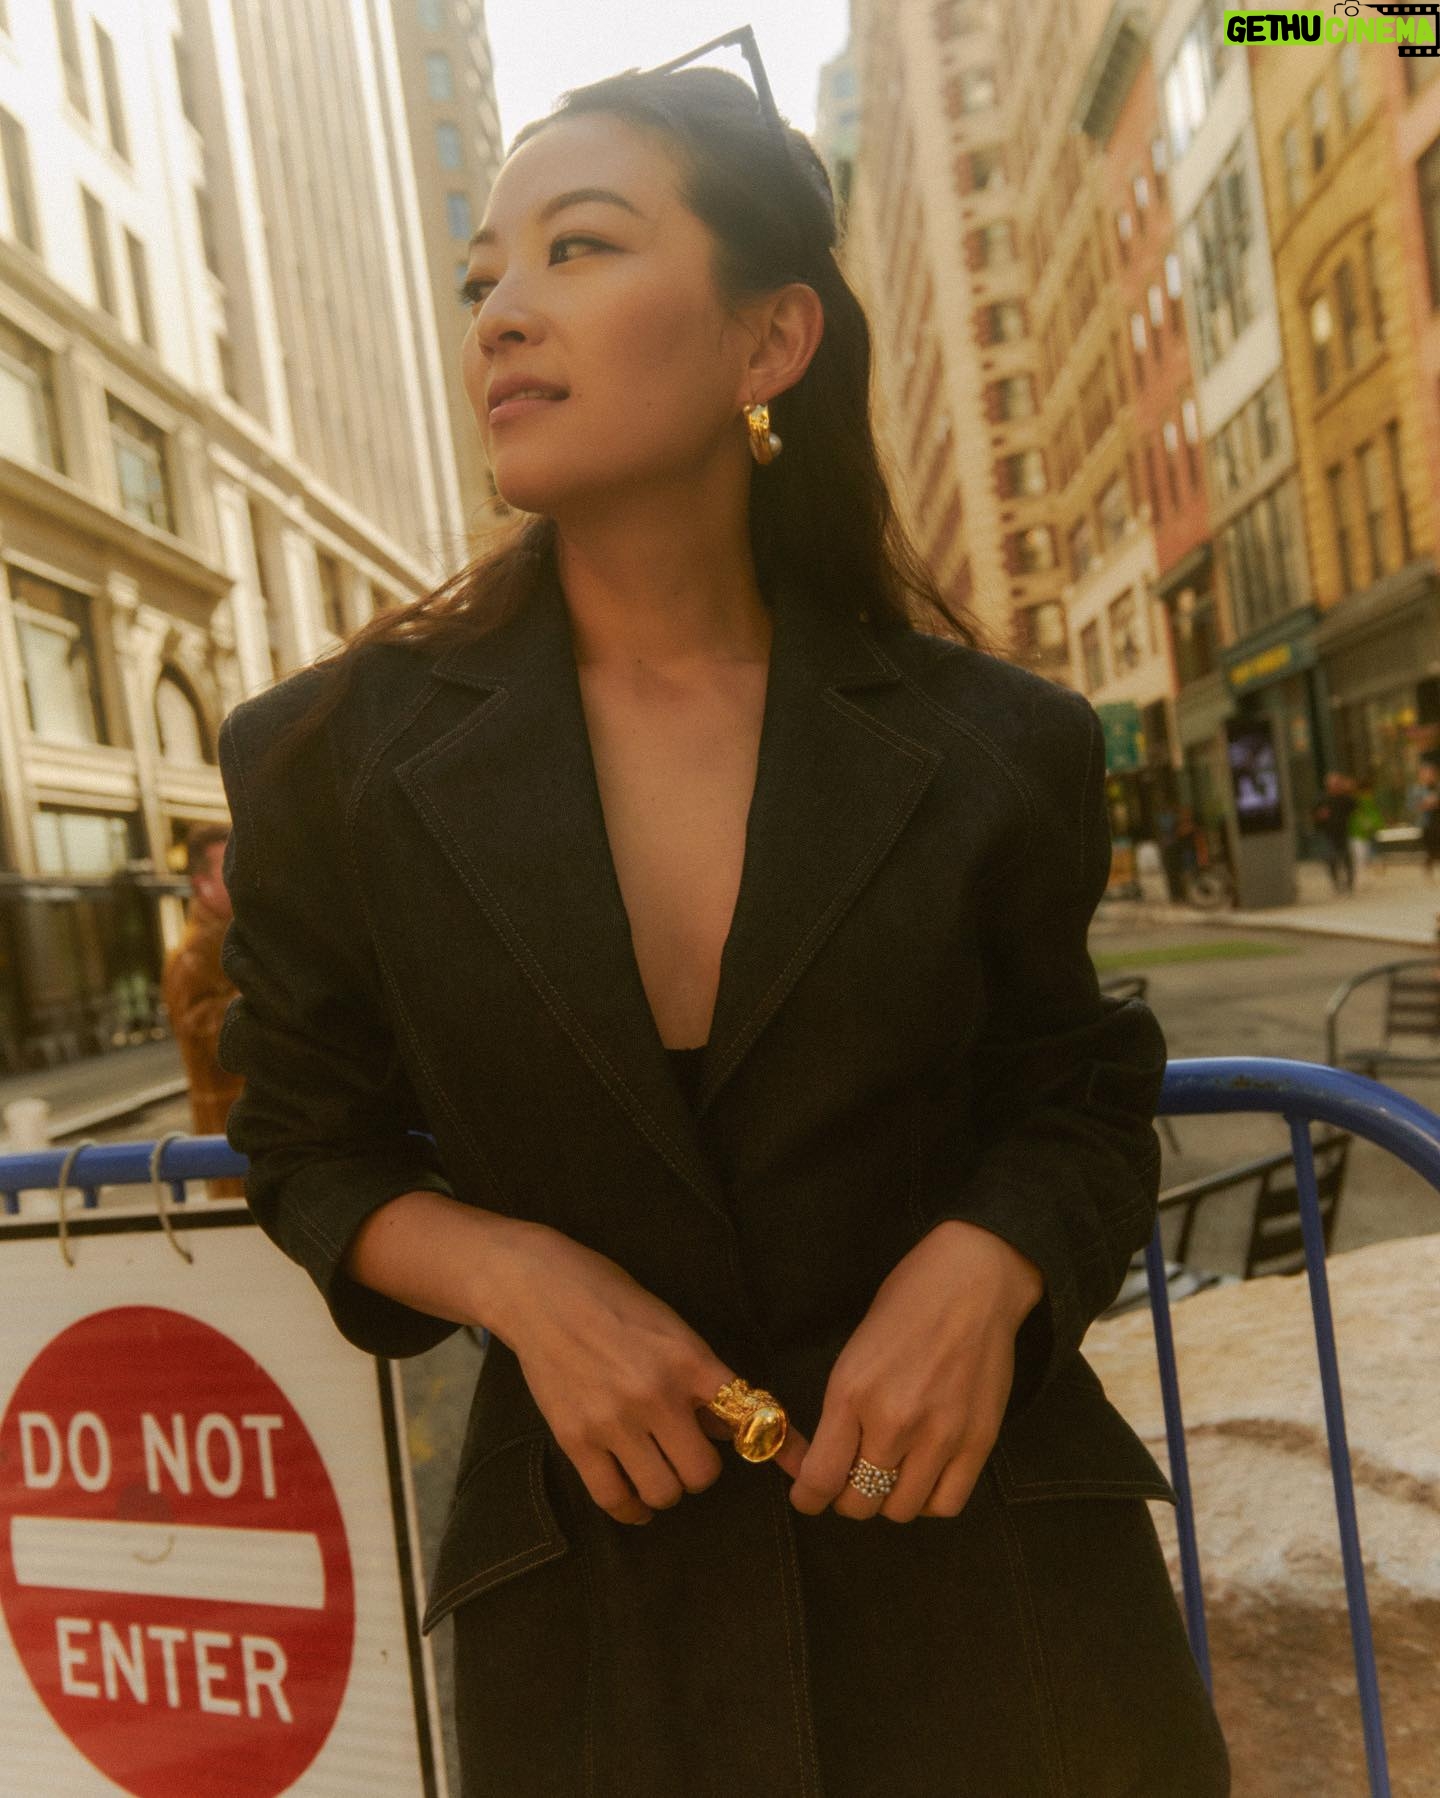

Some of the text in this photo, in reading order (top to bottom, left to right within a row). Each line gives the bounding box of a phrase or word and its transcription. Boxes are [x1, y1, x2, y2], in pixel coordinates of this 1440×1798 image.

[19, 1411, 285, 1500] DO NOT
[55, 1616, 294, 1724] ENTER
